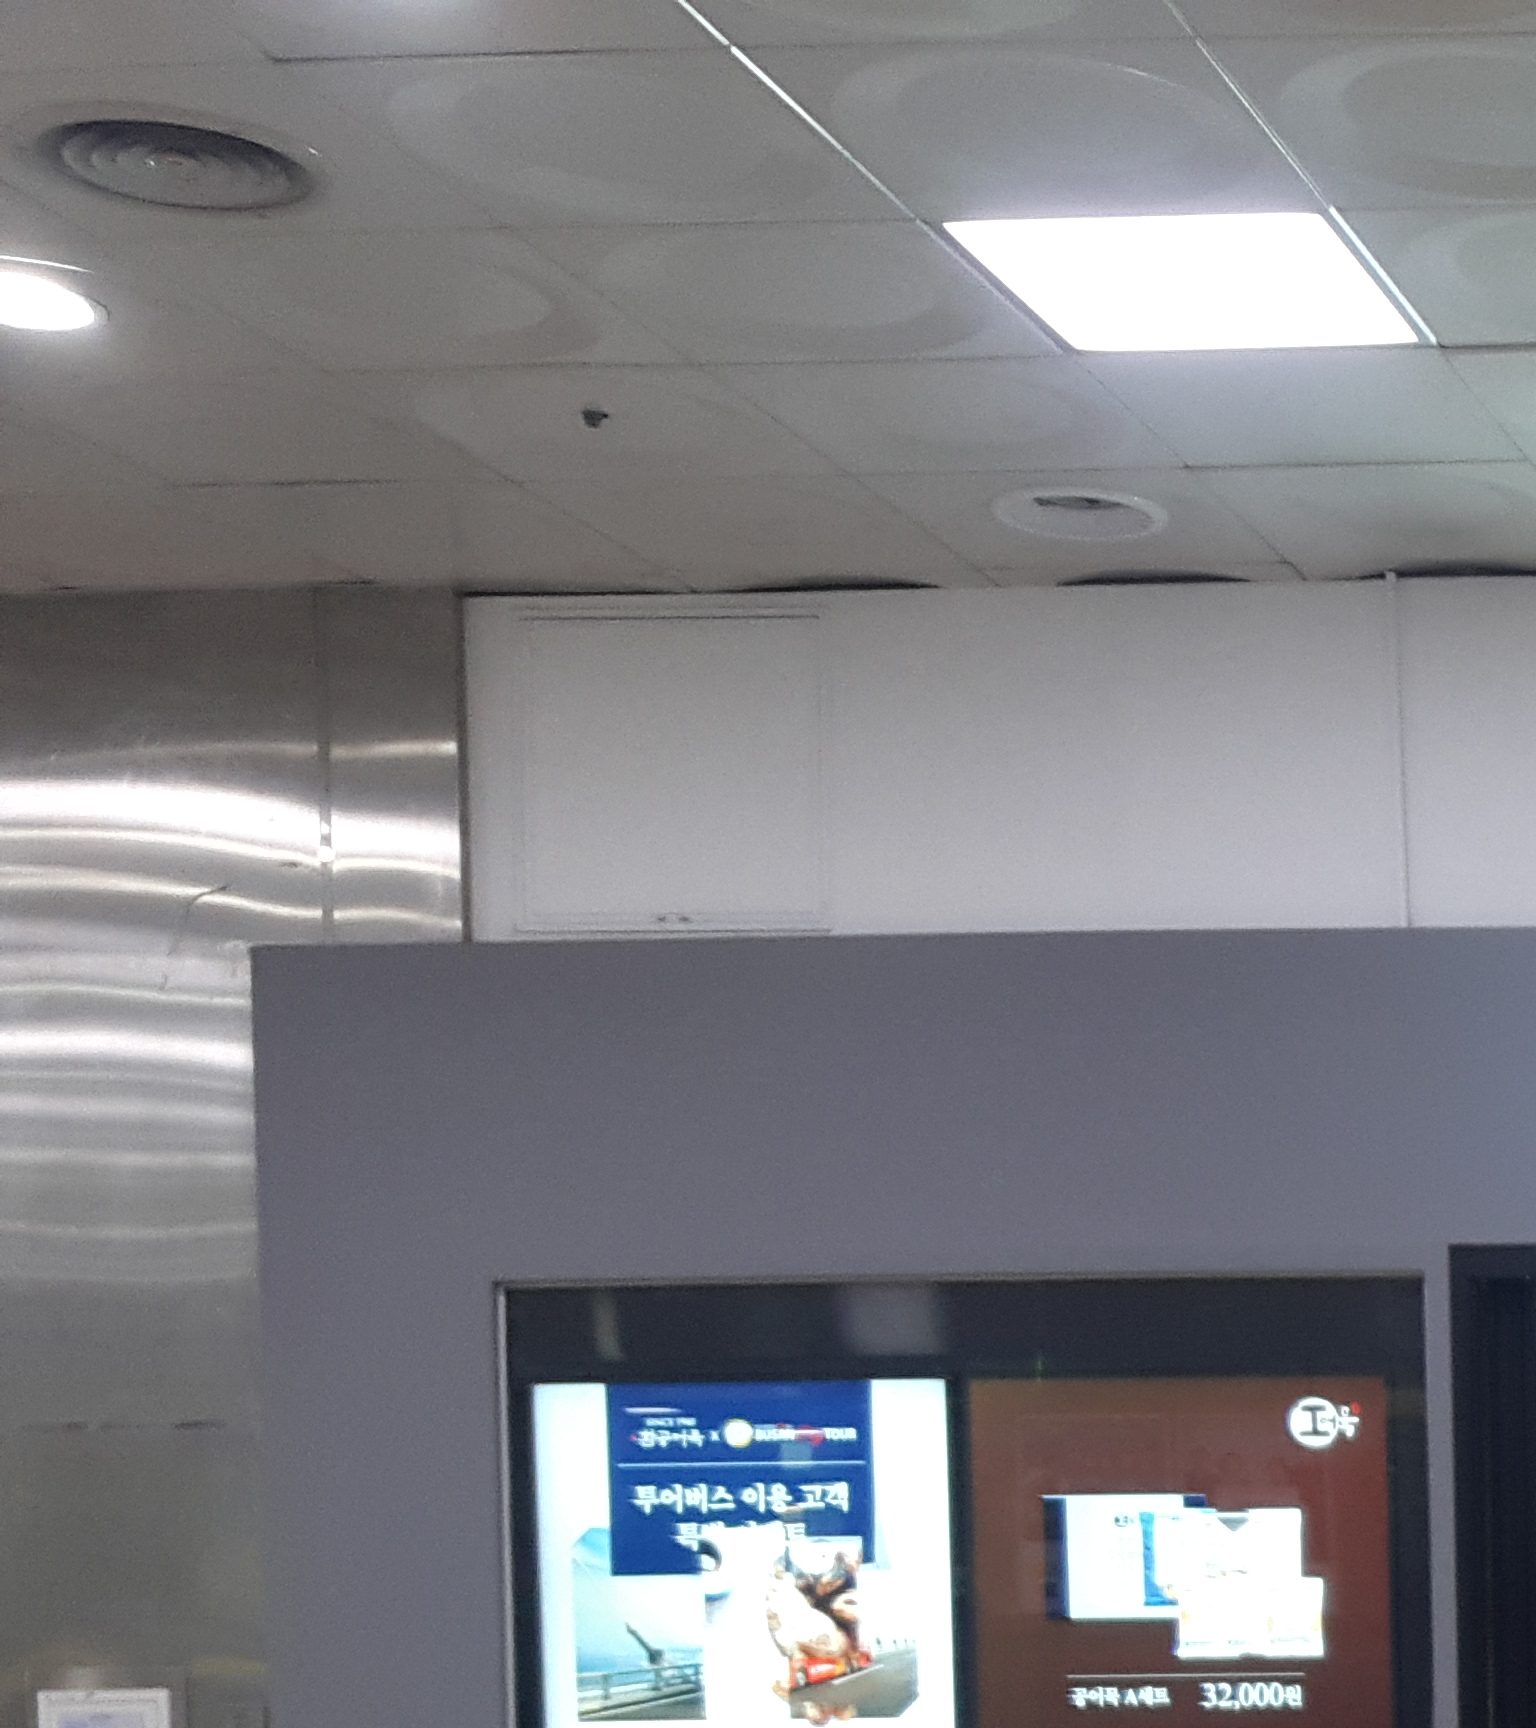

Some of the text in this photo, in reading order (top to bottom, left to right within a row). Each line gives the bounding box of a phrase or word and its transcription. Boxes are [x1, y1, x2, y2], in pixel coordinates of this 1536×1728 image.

[630, 1481, 850, 1515] 투어버스 이용 고객
[1199, 1681, 1303, 1711] 32,000원
